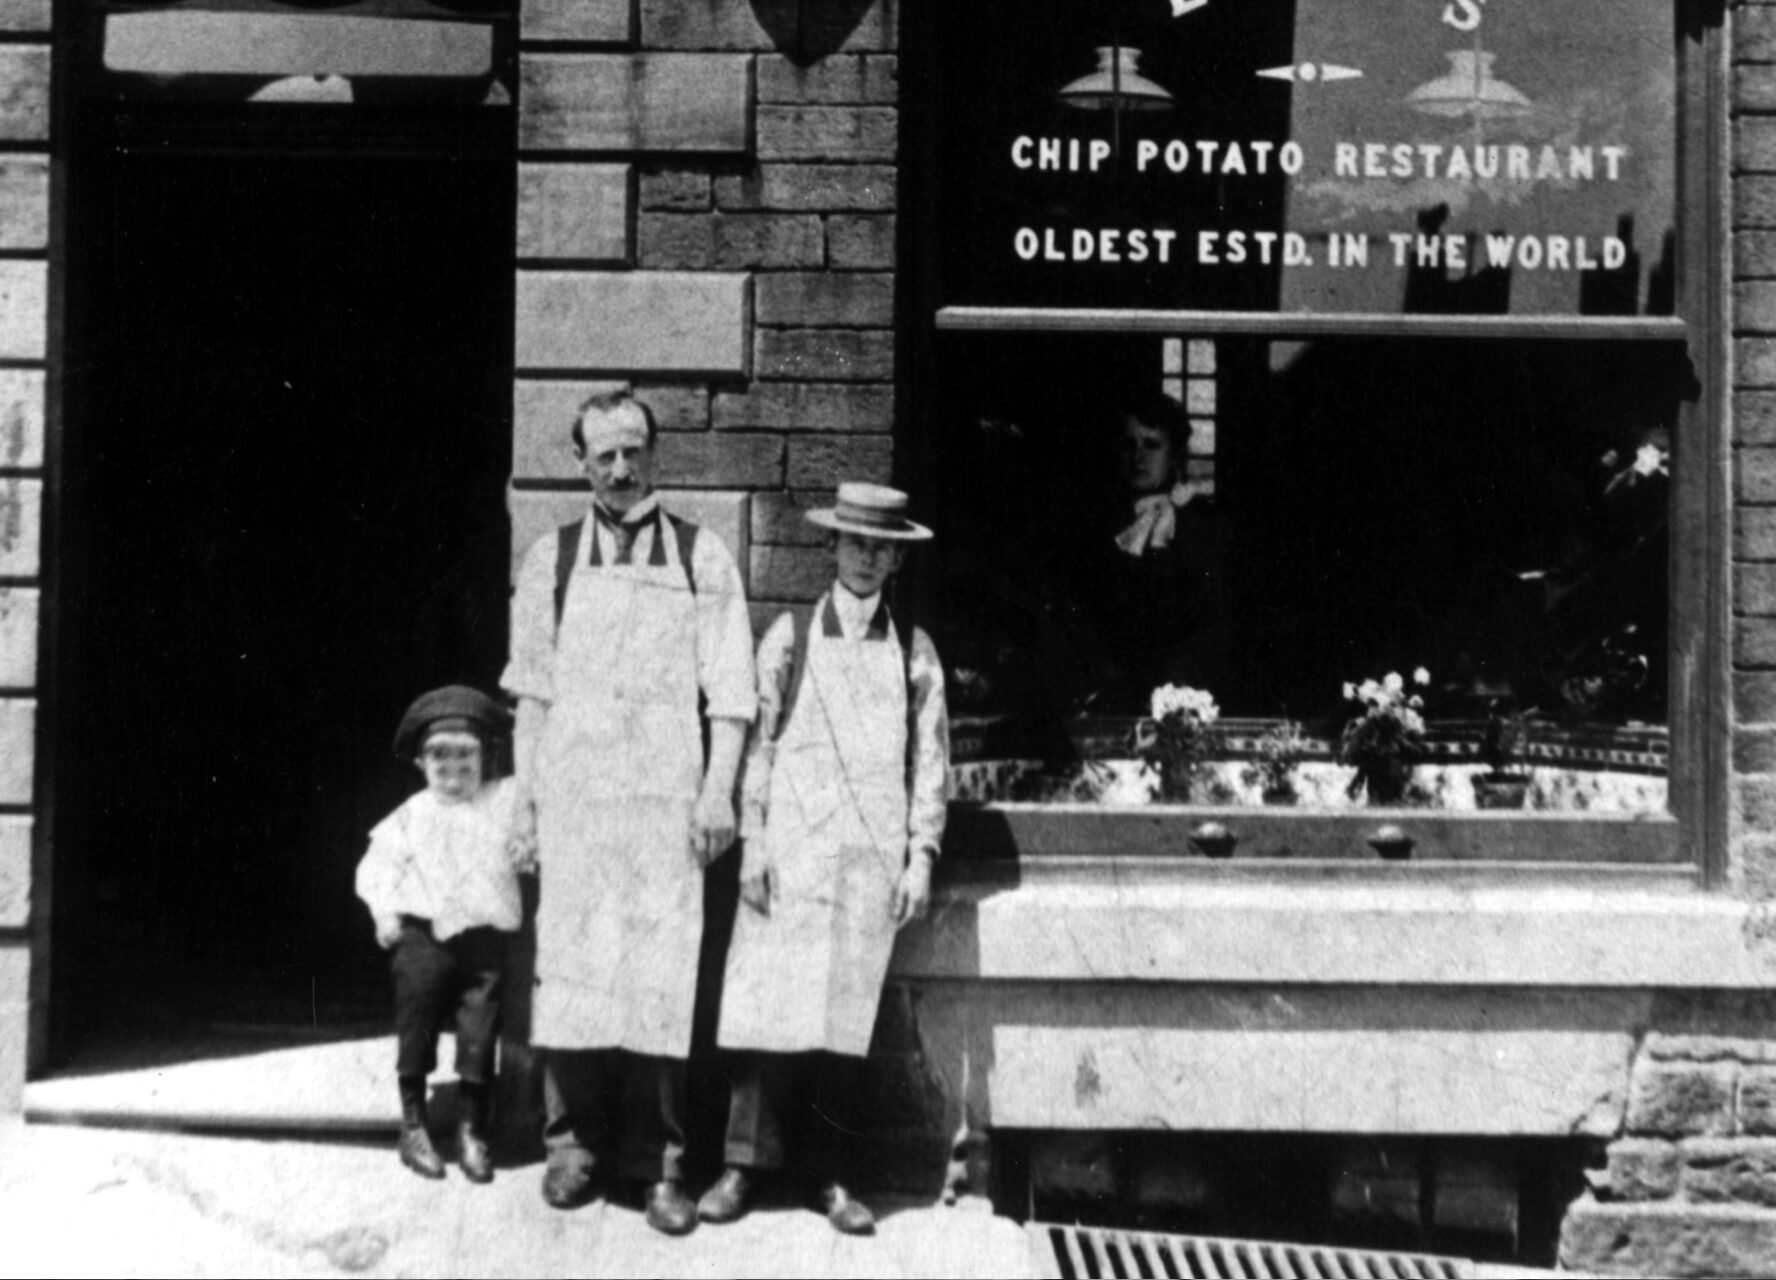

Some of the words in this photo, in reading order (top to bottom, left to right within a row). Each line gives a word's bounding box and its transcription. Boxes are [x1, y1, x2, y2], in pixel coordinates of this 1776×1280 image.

[1011, 136, 1111, 171] CHIP
[1137, 141, 1304, 175] POTATO
[1336, 144, 1625, 179] RESTAURANT
[1015, 228, 1175, 262] OLDEST
[1199, 231, 1313, 266] ESTD.
[1329, 233, 1369, 268] IN
[1389, 233, 1467, 269] THE
[1487, 236, 1626, 269] WORLD
